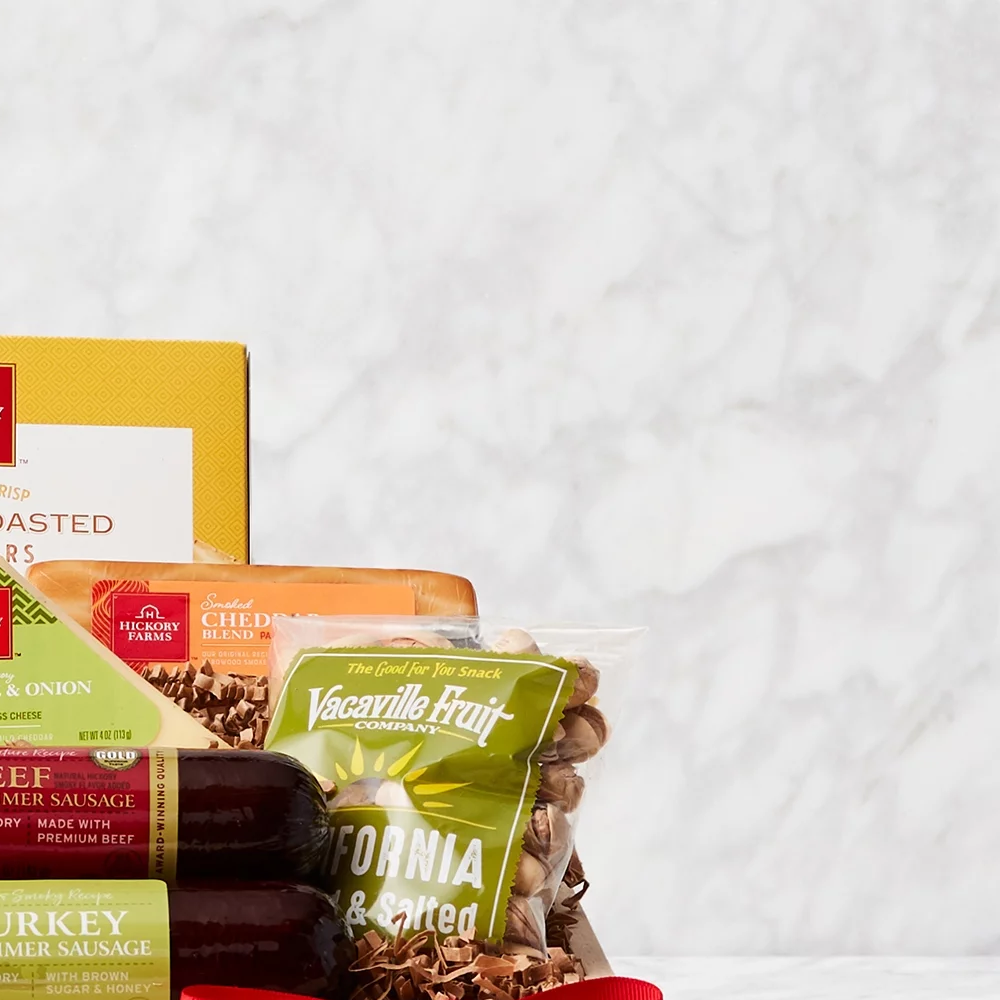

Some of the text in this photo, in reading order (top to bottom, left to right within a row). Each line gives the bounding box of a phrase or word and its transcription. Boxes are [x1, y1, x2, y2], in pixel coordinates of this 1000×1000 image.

[200, 592, 254, 611] Smoked
[119, 621, 180, 632] HICKORY
[128, 632, 172, 642] FARMS
[202, 629, 254, 640] BLEND
[252, 650, 268, 658] RECI
[347, 661, 503, 680] The Good For You Snack
[6, 683, 20, 698] &
[25, 680, 93, 697] ONION
[10, 711, 42, 721] CHEESE
[308, 683, 514, 747] Vacaville Fruit
[355, 720, 440, 734] COMPANY
[32, 748, 78, 761] Recipe
[96, 751, 136, 760] GOLD
[50, 793, 136, 808] SAUSAGE
[37, 818, 110, 830] MADE WITH
[156, 783, 165, 874] AWARD-WINNING
[37, 833, 135, 845] PREMIUM BEEF
[346, 889, 367, 926] &
[376, 891, 479, 935] Salted
[58, 940, 152, 956] SAUSAGE
[46, 971, 129, 982] WITH BROWN
[46, 983, 151, 995] SUGAR & HONEY
